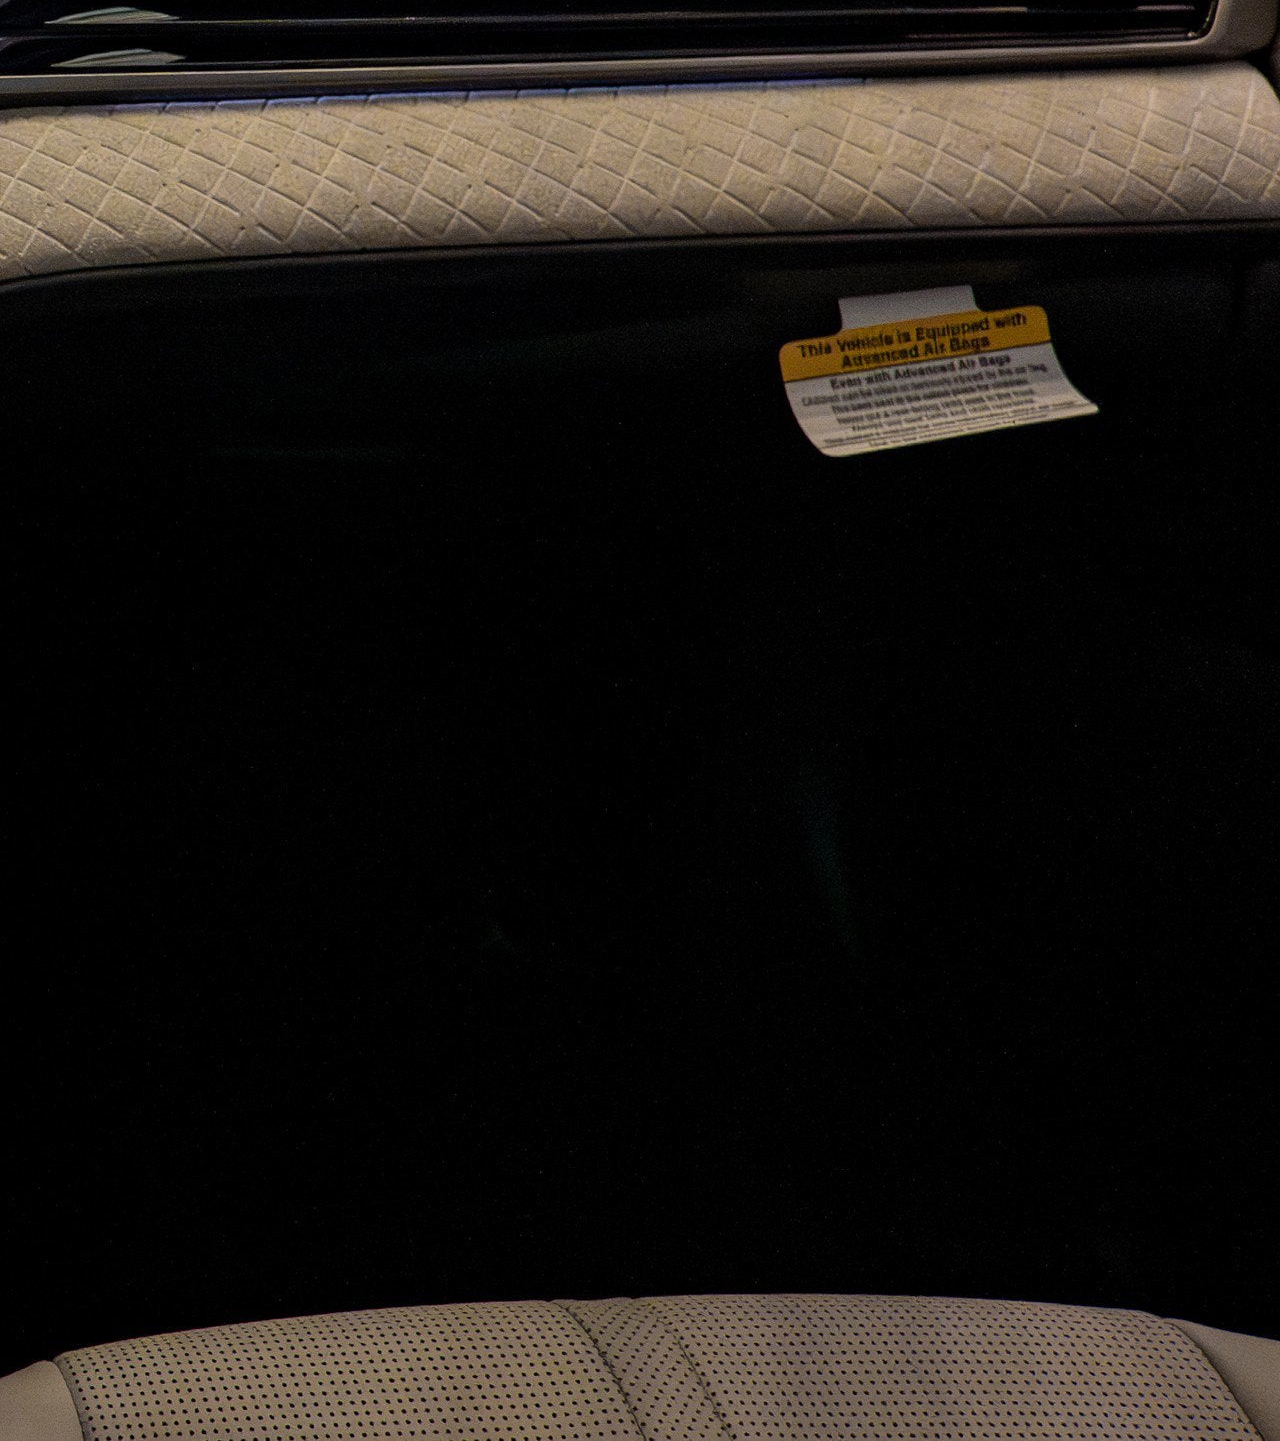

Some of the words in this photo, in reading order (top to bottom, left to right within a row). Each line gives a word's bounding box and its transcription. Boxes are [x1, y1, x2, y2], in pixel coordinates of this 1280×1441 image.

[796, 342, 832, 358] This
[837, 332, 894, 353] Vehicle
[896, 329, 912, 344] is
[915, 318, 990, 346] Equipped
[994, 312, 1028, 328] with
[841, 343, 919, 368] Advanced
[924, 338, 946, 356] Air
[949, 334, 990, 354] Bags
[830, 375, 862, 391] Even
[864, 370, 891, 385] with
[894, 362, 956, 382] Advanced
[958, 358, 977, 370] Air
[978, 353, 1012, 368] Bags
